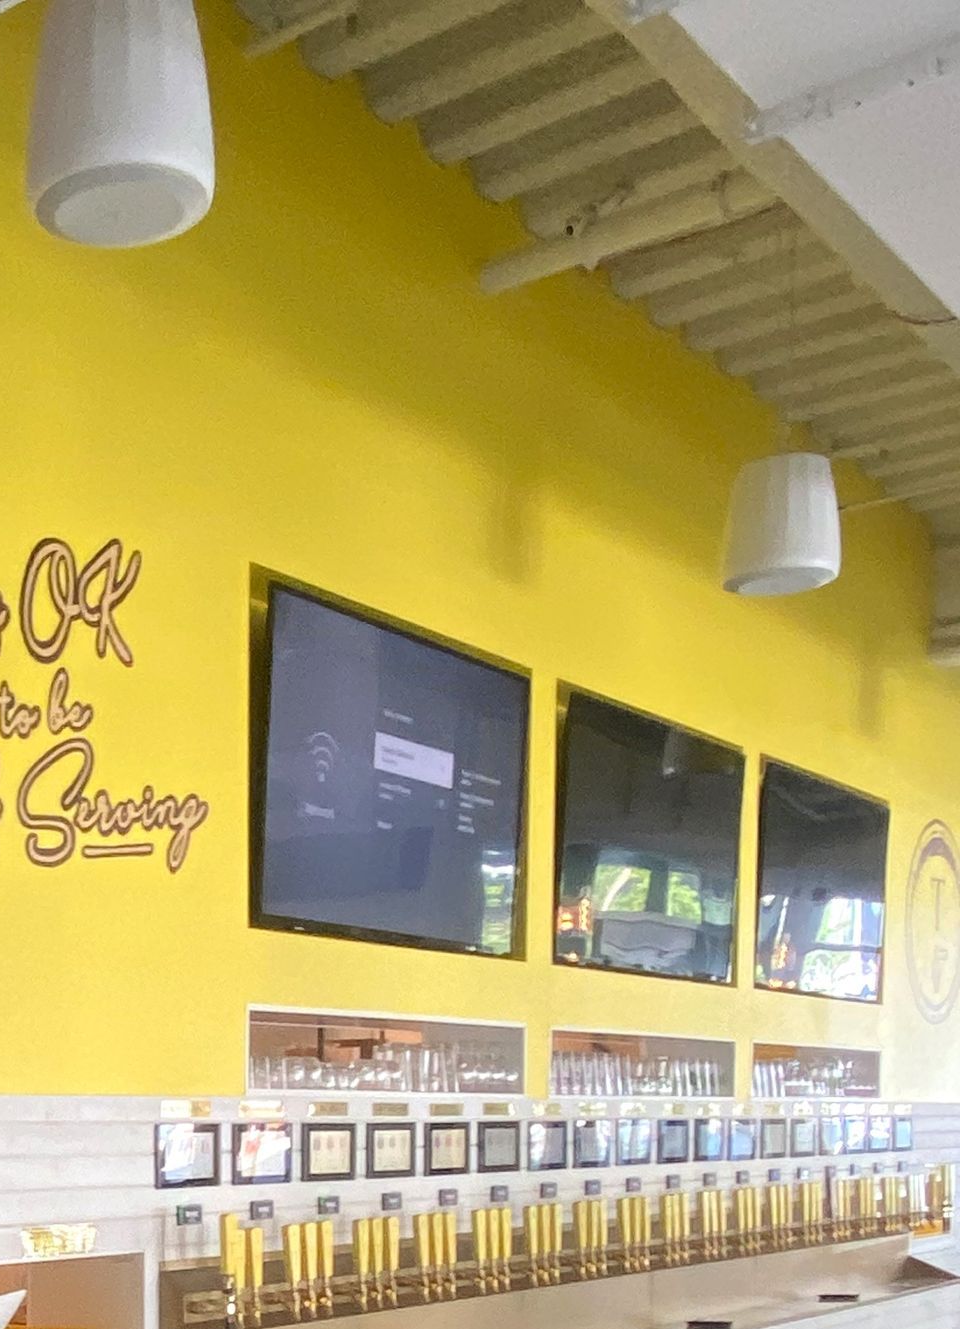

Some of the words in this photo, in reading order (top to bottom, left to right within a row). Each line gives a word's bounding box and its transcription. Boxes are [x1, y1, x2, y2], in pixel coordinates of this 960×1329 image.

[20, 538, 142, 667] OK
[46, 668, 94, 735] be
[17, 738, 209, 874] Serving
